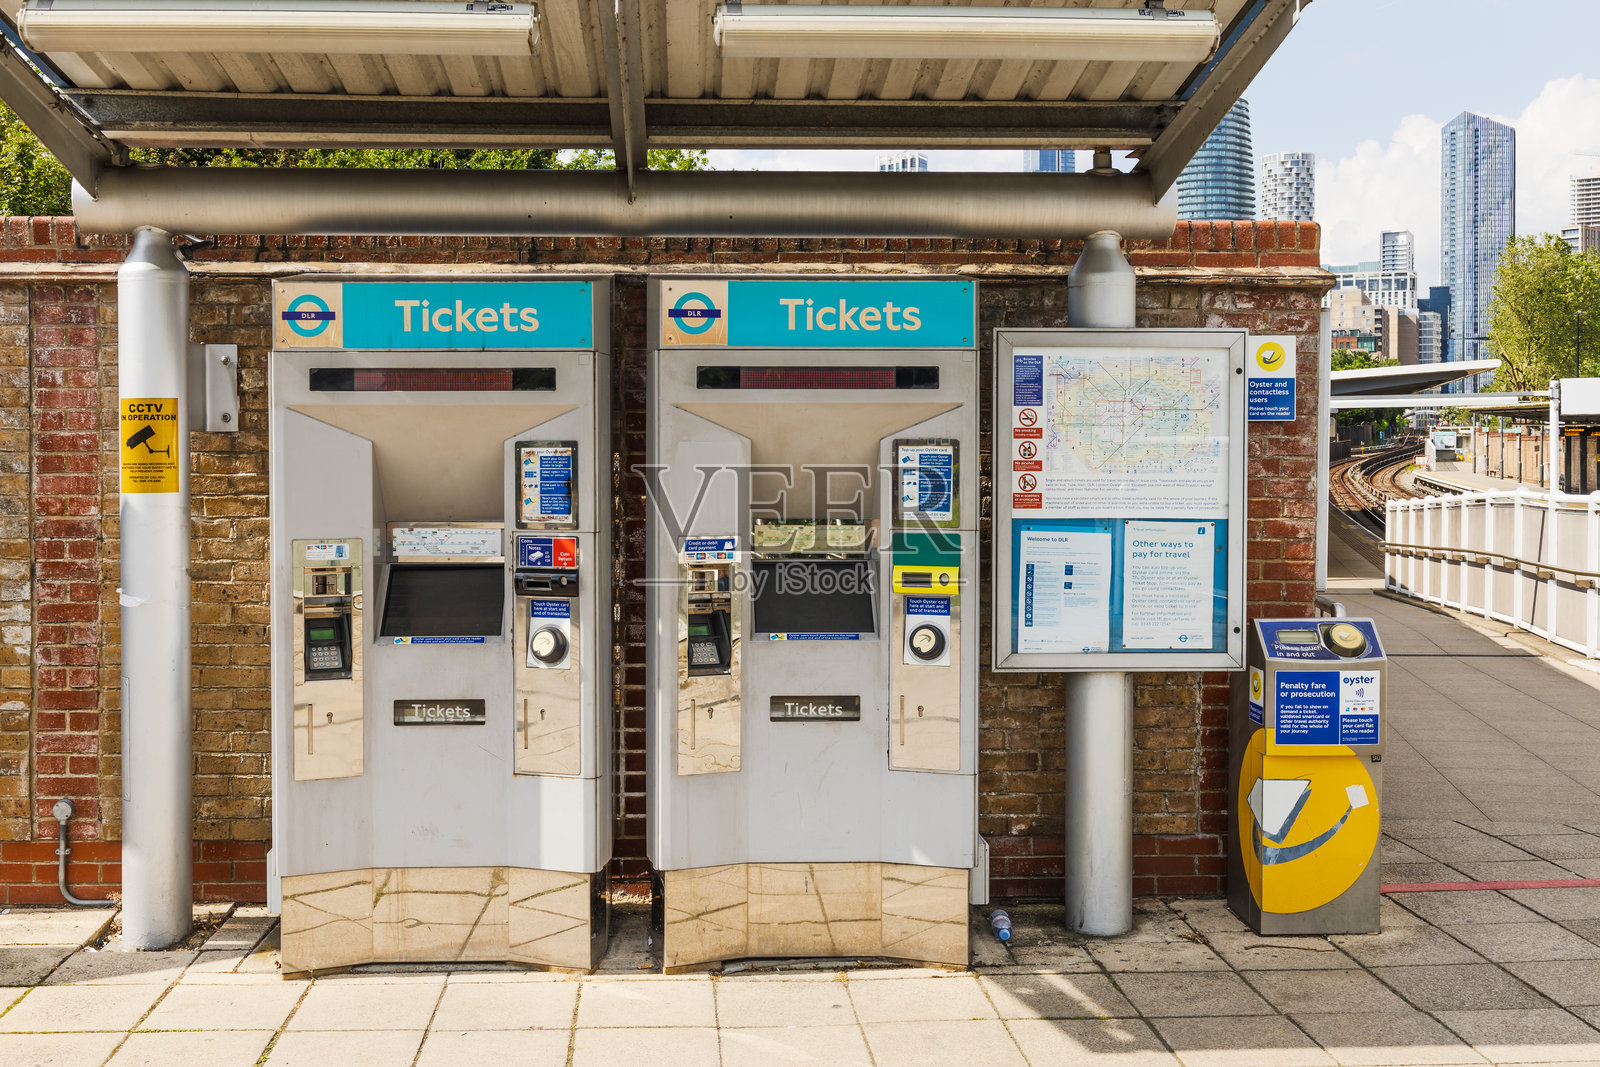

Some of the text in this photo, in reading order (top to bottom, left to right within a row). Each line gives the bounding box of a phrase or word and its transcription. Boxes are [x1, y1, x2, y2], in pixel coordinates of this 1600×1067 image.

[395, 299, 539, 332] Tickets
[780, 298, 921, 331] Tickets
[129, 404, 164, 412] CCTV
[1281, 682, 1308, 690] Penalty
[1343, 676, 1374, 686] oyster
[412, 704, 470, 718] Tickets
[785, 703, 843, 715] Tickets
